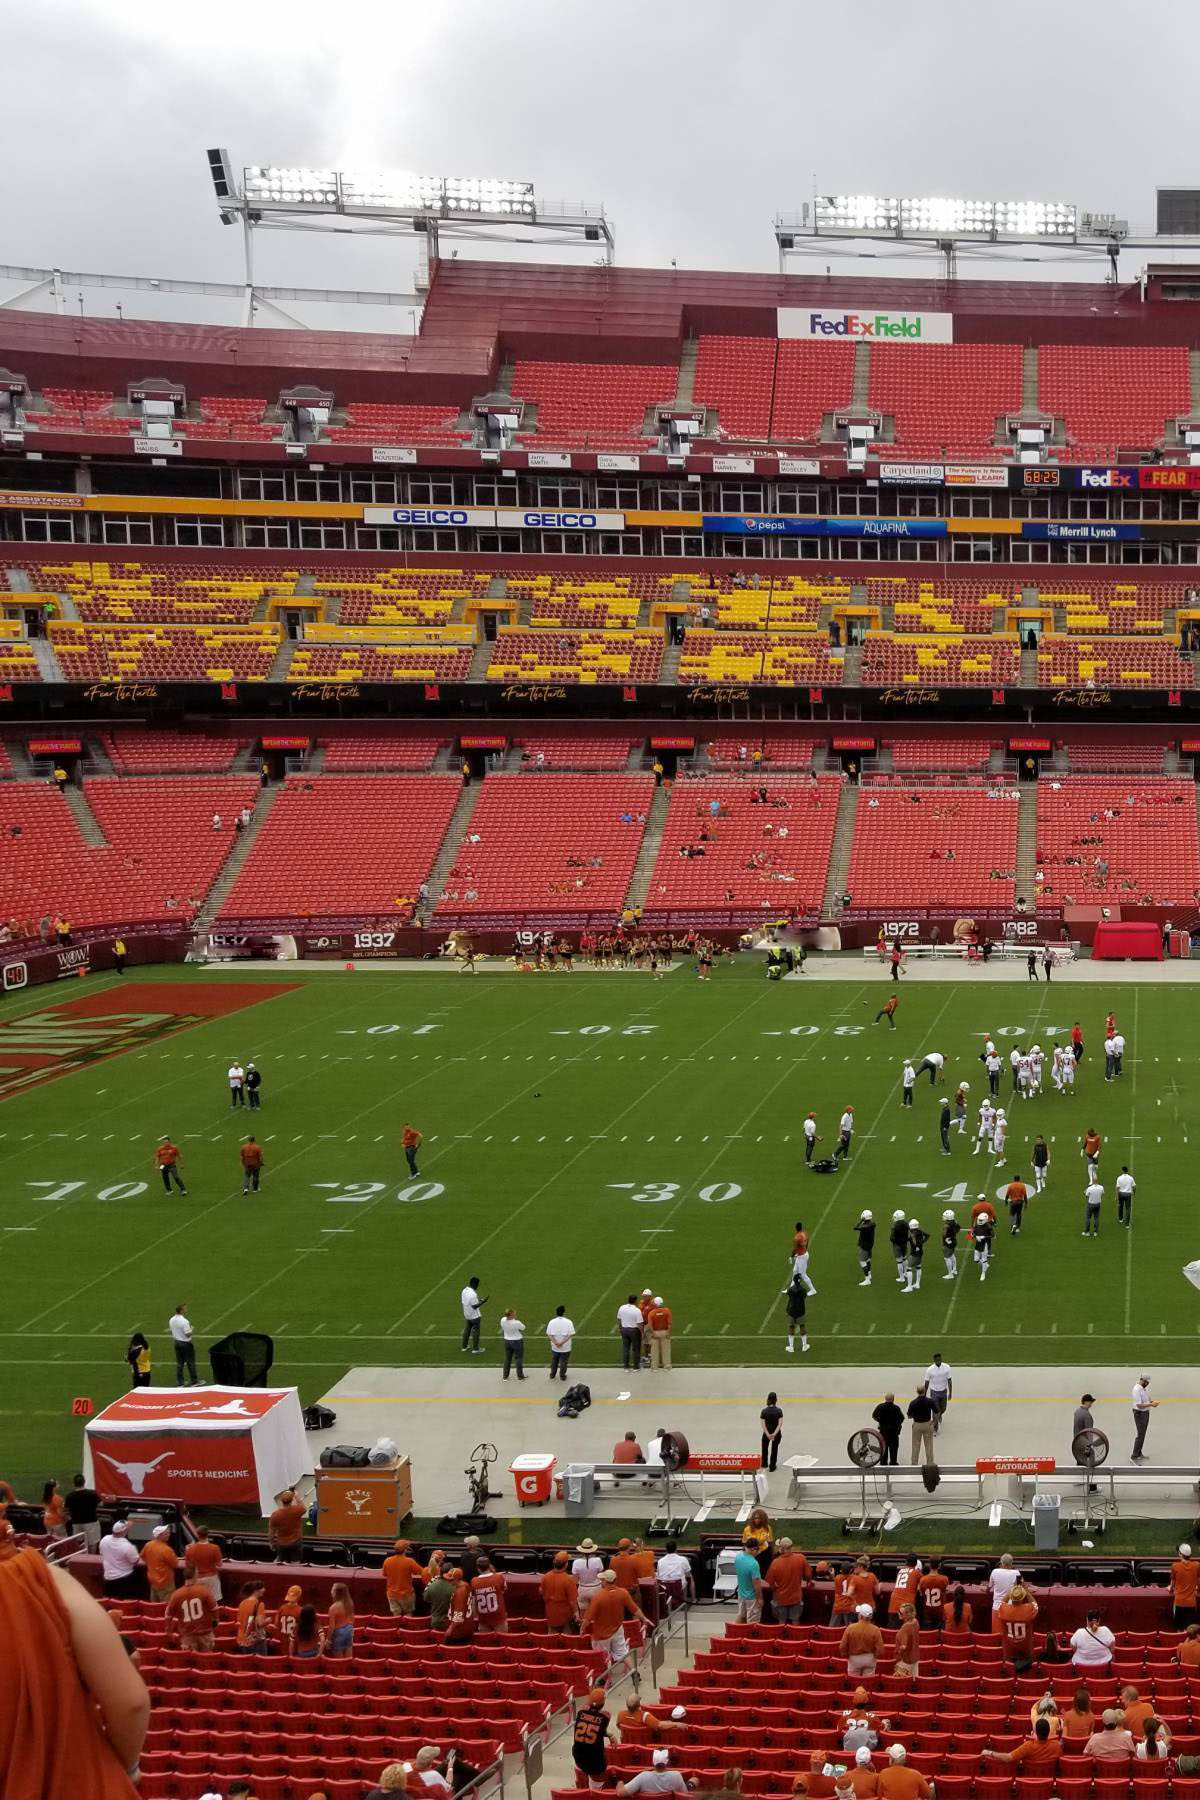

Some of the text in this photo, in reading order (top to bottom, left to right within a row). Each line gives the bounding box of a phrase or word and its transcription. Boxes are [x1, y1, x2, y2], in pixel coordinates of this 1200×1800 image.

[810, 314, 921, 338] FedExField
[882, 466, 933, 477] Carpetland
[1025, 471, 1059, 483] 68:25
[1081, 470, 1131, 487] FedEx
[393, 509, 468, 526] GEICO
[523, 513, 597, 528] GEICO
[758, 521, 785, 531] pepsi
[863, 522, 909, 534] AQUAFINA
[1059, 526, 1117, 538] Merrill Lynch
[882, 922, 920, 936] 1972
[354, 933, 395, 948] 1937
[1019, 1059, 1031, 1069] 54
[32, 1181, 149, 1201] 10
[325, 1182, 445, 1202] 20
[631, 1182, 742, 1202] 30
[932, 1182, 1035, 1202] 40
[74, 1400, 89, 1414] 20
[699, 1459, 743, 1467] GATORADE
[994, 1462, 1039, 1471] GATORADE
[167, 1469, 250, 1480] SPORTS MEDICINE
[520, 1475, 538, 1494] G
[344, 1489, 373, 1500] TEXAS
[477, 1594, 498, 1614] 20
[925, 1588, 941, 1608] 12
[180, 1598, 204, 1622] 10
[280, 1615, 296, 1634] 12
[1005, 1622, 1026, 1640] 10
[574, 1723, 600, 1745] 25
